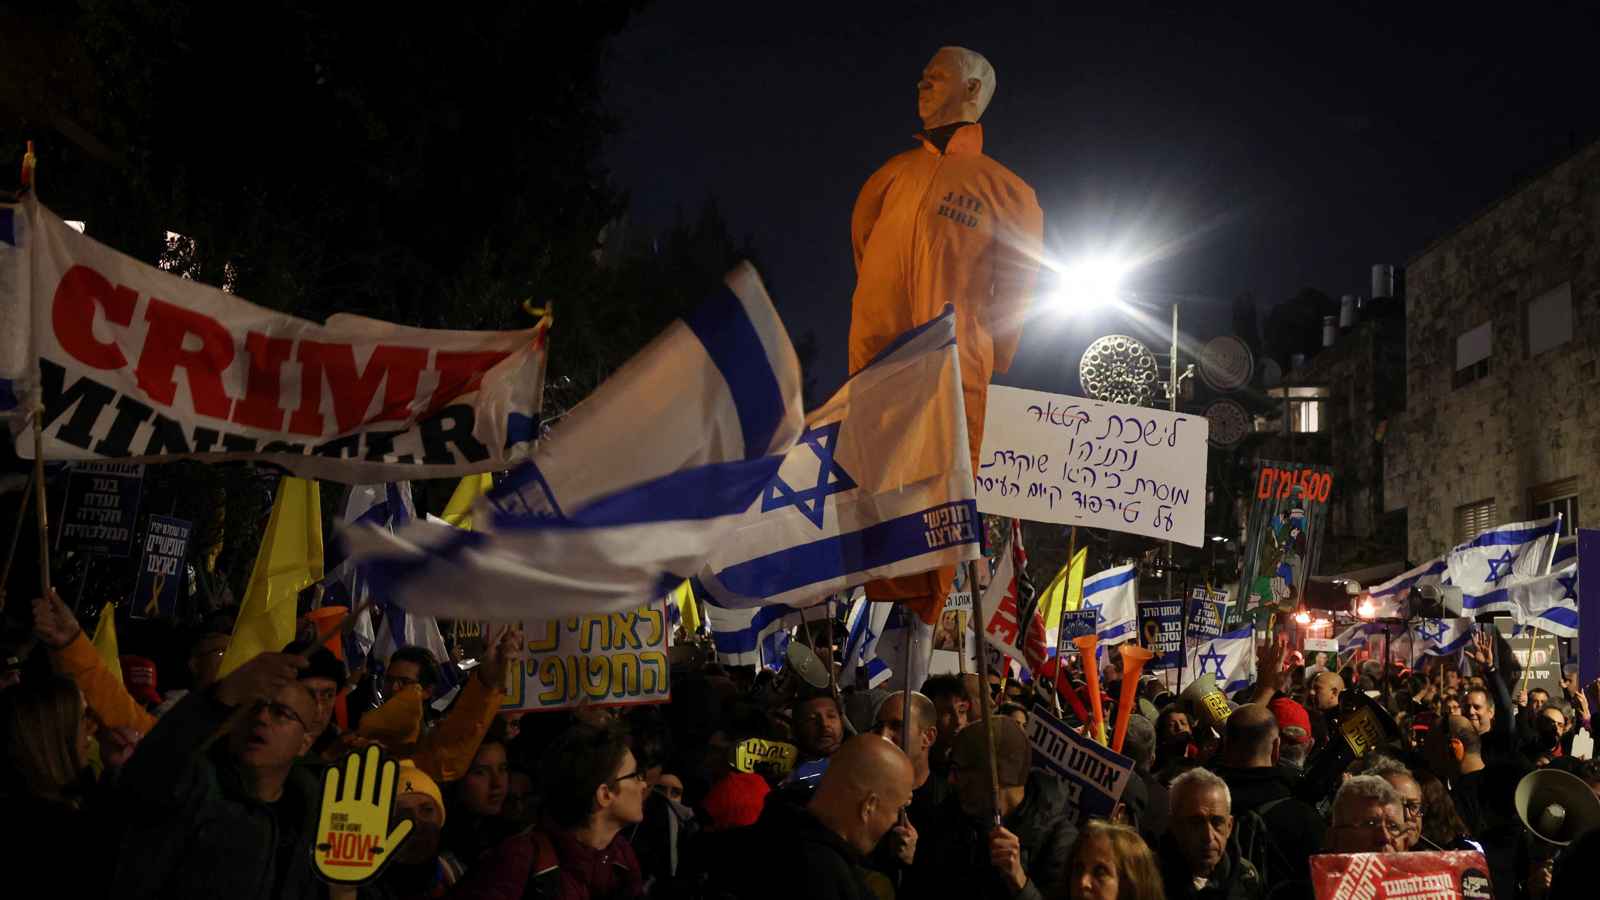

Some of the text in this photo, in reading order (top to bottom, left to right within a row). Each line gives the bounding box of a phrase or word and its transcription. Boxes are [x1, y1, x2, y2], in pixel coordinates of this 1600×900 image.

[38, 357, 490, 465] MINER
[1068, 438, 1139, 471] נתניהו
[1298, 468, 1332, 504] 500
[923, 505, 970, 529] חופשי
[1153, 505, 1175, 532] על
[925, 522, 975, 548] בארצנו
[1162, 621, 1182, 632] בעד
[1028, 720, 1120, 792] אנחנו הרוב
[326, 831, 381, 861] NOW
